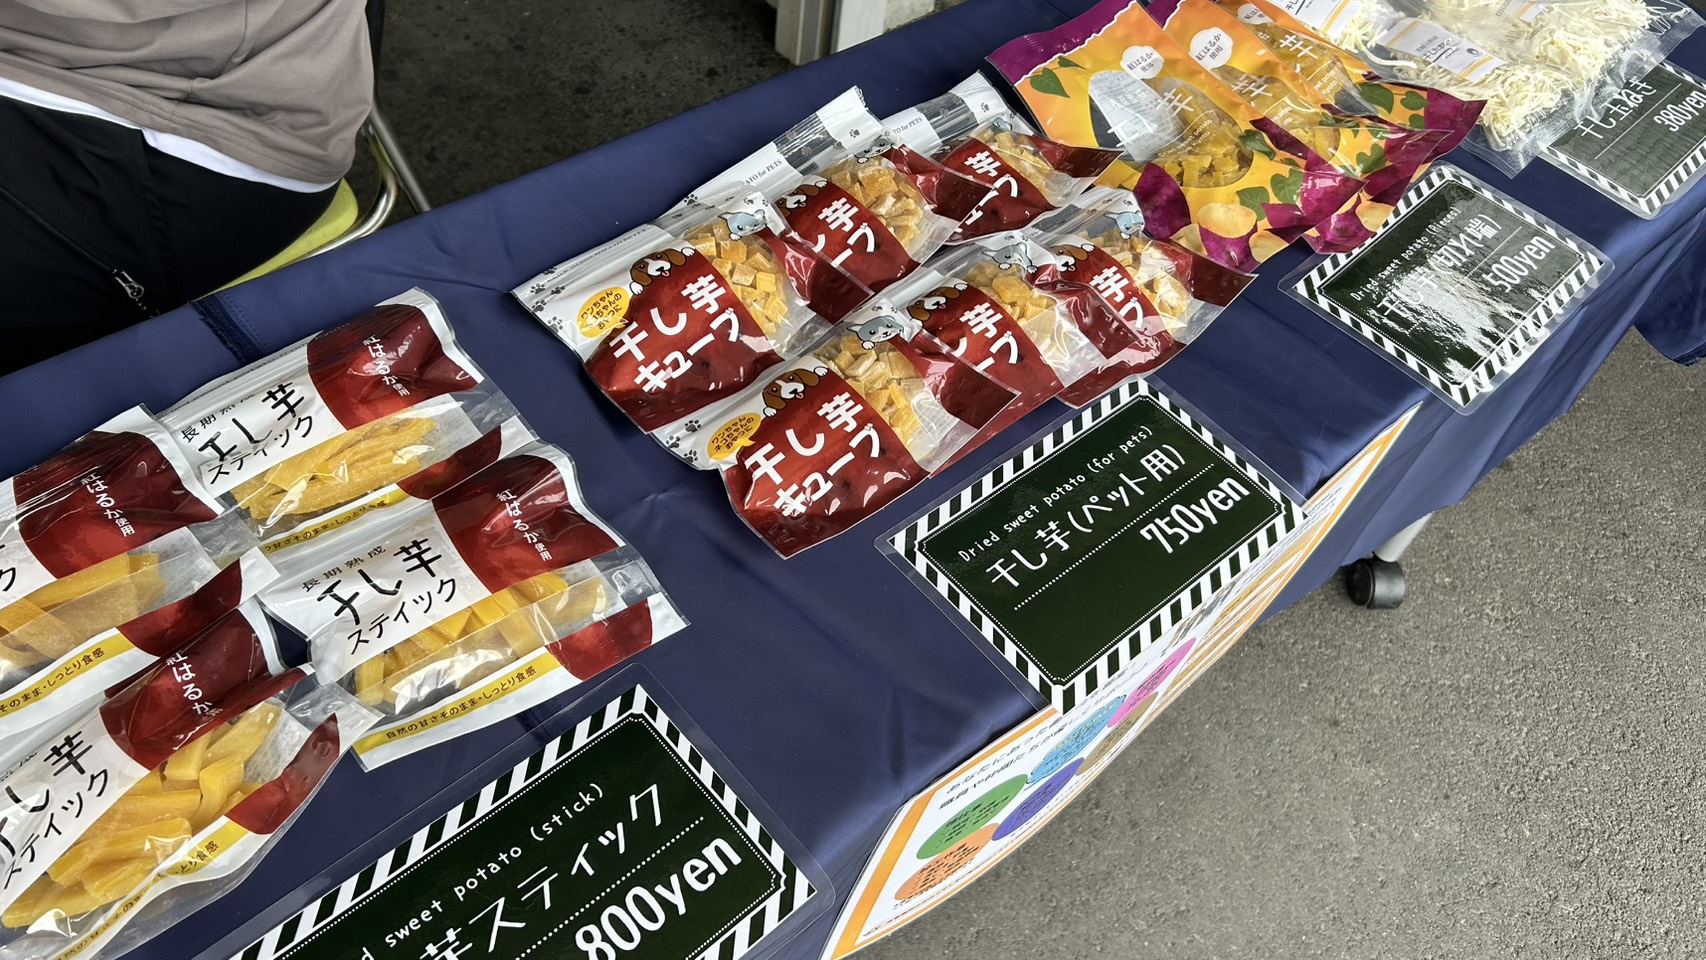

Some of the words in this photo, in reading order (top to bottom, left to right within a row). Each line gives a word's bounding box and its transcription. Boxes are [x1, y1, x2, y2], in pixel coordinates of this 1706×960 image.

[1573, 76, 1657, 138] 干し玉ねぎ
[1653, 90, 1706, 132] 380yen
[757, 169, 767, 178] for
[766, 159, 782, 172] PETS
[964, 150, 1001, 179] 芋
[1350, 278, 1379, 301] Dried
[1378, 258, 1402, 280] sweet
[1401, 236, 1429, 260] potato
[1426, 206, 1461, 235] (Pieces)
[1482, 235, 1555, 292] 500yen
[581, 290, 613, 319] ワンちゃん
[609, 273, 726, 363] 干し芋
[633, 307, 740, 393] キューブ
[711, 416, 746, 444] ワンちゃん
[714, 416, 755, 452] ネコちゃんの
[725, 425, 753, 450] おやつに
[745, 391, 864, 485] 干し芋
[81, 472, 136, 538] 紅はるか使用
[773, 423, 880, 518] キューブ
[958, 531, 1000, 563] Dried
[1003, 504, 1039, 534] sweet
[1043, 472, 1086, 506] potato
[1086, 451, 1116, 475] (for
[1118, 425, 1153, 454] pets)
[496, 489, 552, 561] 紅はるか使用
[985, 443, 1186, 588] 干し芋(ペット用)
[1139, 476, 1251, 554] 750yen
[301, 545, 387, 593] 長期熟成
[317, 538, 442, 626] 干し芋
[385, 665, 537, 740] 自然の甘さそのまま・しっとり食感
[385, 899, 443, 948] sweet
[454, 845, 522, 901] potato
[529, 782, 604, 843] (stick)
[575, 837, 742, 960] 800yen
